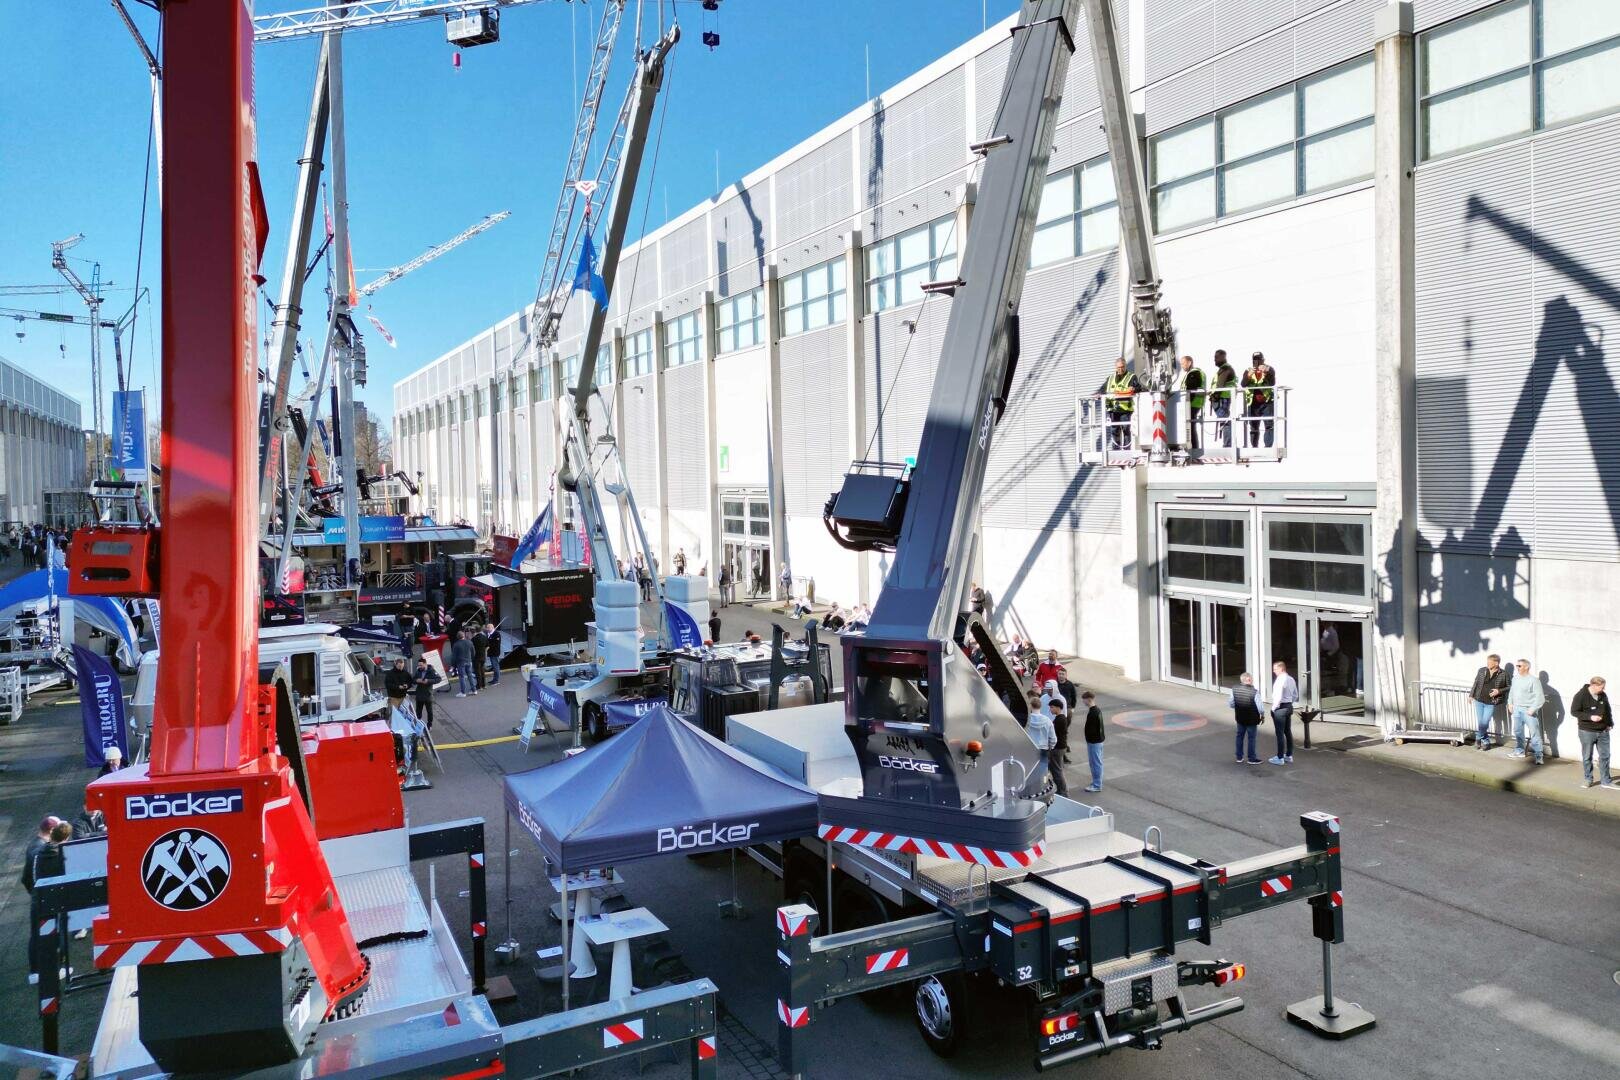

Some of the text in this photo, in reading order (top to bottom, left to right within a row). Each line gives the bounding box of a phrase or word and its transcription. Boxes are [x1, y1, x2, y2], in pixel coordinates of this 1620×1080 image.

[327, 526, 346, 535] MK
[878, 755, 939, 774] Böcker
[125, 792, 242, 820] Böcker
[518, 800, 542, 841] Böcker
[657, 822, 760, 853] Böcker
[1049, 1031, 1077, 1045] Böcker
